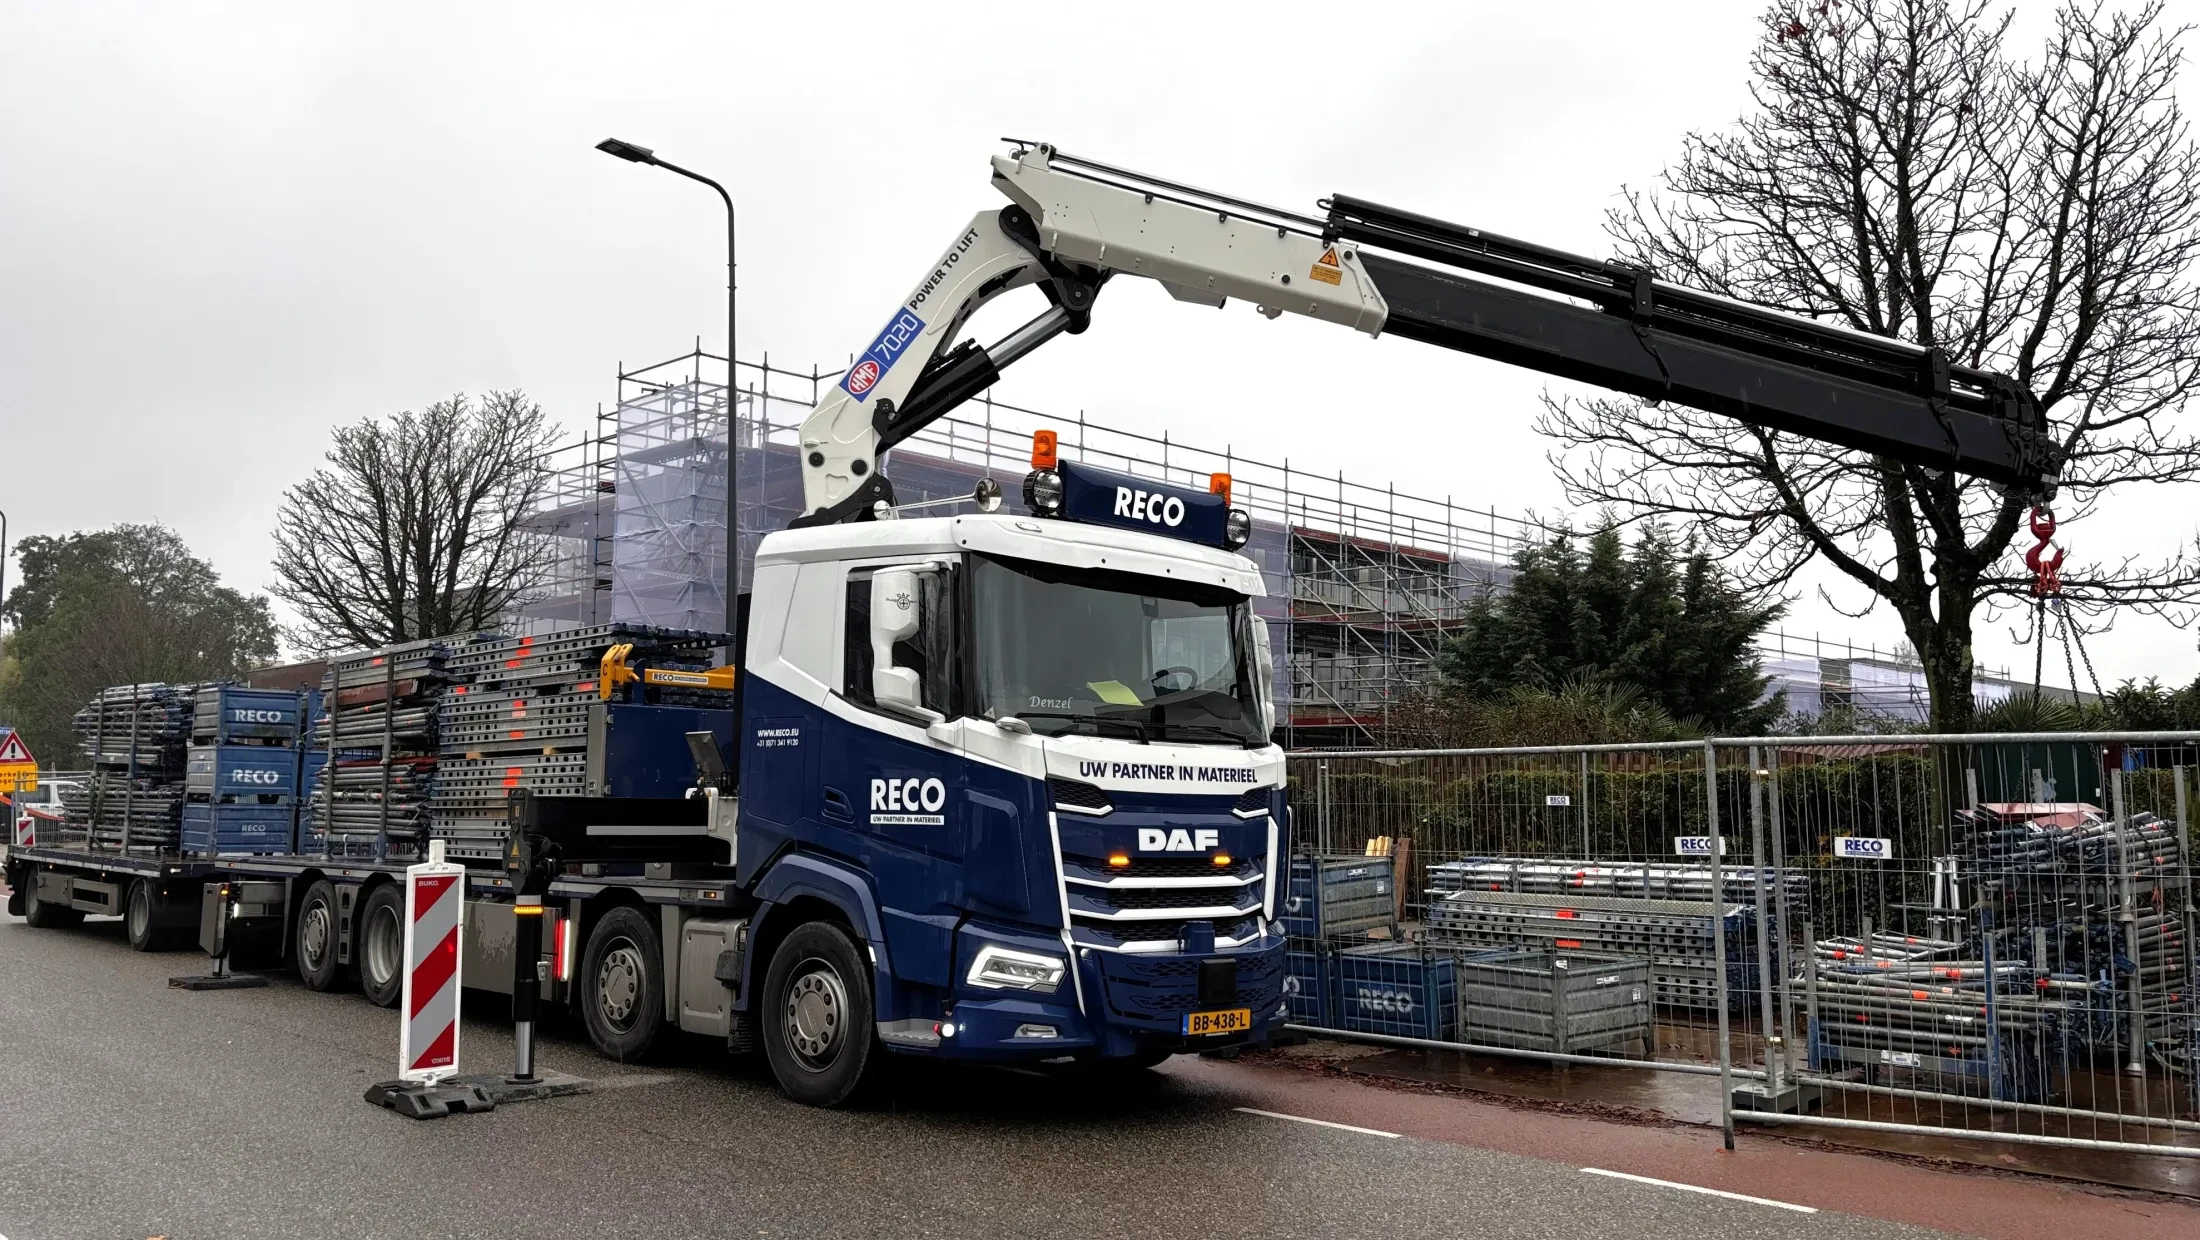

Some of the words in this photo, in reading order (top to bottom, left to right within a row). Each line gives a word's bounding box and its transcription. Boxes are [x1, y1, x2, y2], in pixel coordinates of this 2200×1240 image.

[909, 269, 946, 310] POWER
[942, 252, 960, 269] TO
[957, 228, 979, 253] LIFT
[874, 313, 918, 360] 7020
[851, 364, 877, 392] HMF
[1114, 486, 1185, 527] RECO
[653, 673, 674, 682] RECO
[1029, 696, 1073, 709] Denzel
[235, 709, 282, 723] RECO
[757, 728, 799, 737] WWW.RECO.EU
[232, 769, 279, 784] RECO
[1080, 761, 1107, 778] UW
[1112, 763, 1174, 780] PARTNER
[1179, 766, 1193, 781] IN
[1198, 767, 1257, 783] MATERIEEL
[870, 778, 946, 812] RECO
[241, 824, 266, 832] RECO
[1138, 828, 1218, 851] DAF
[1845, 839, 1883, 852] RECO
[1359, 988, 1412, 1013] RECO
[1193, 1012, 1246, 1031] BB-438-L
